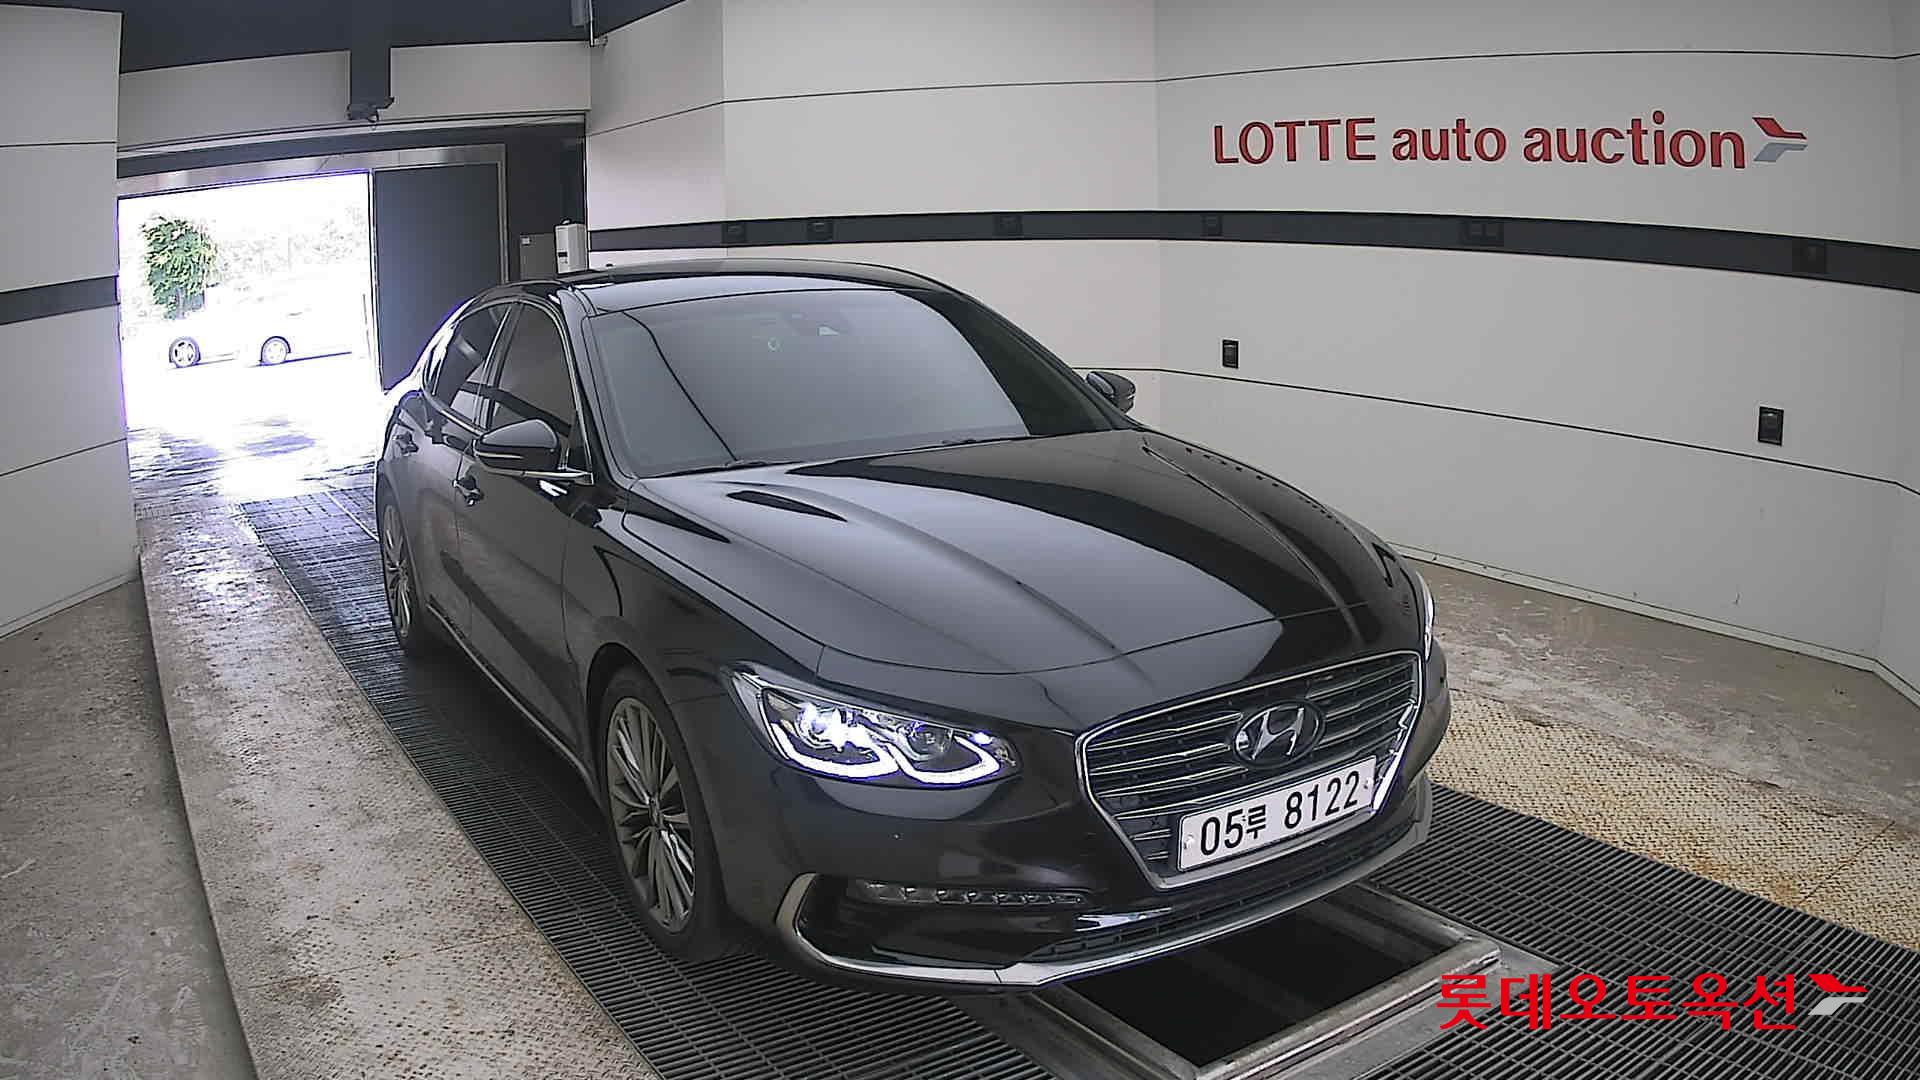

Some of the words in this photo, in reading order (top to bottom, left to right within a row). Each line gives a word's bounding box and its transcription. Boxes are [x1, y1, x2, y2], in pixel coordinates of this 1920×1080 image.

[1213, 117, 1376, 164] LOTTE
[1392, 119, 1507, 162] auto
[1523, 110, 1746, 169] auction
[1200, 804, 1267, 856] 05루
[1284, 770, 1360, 830] 8122
